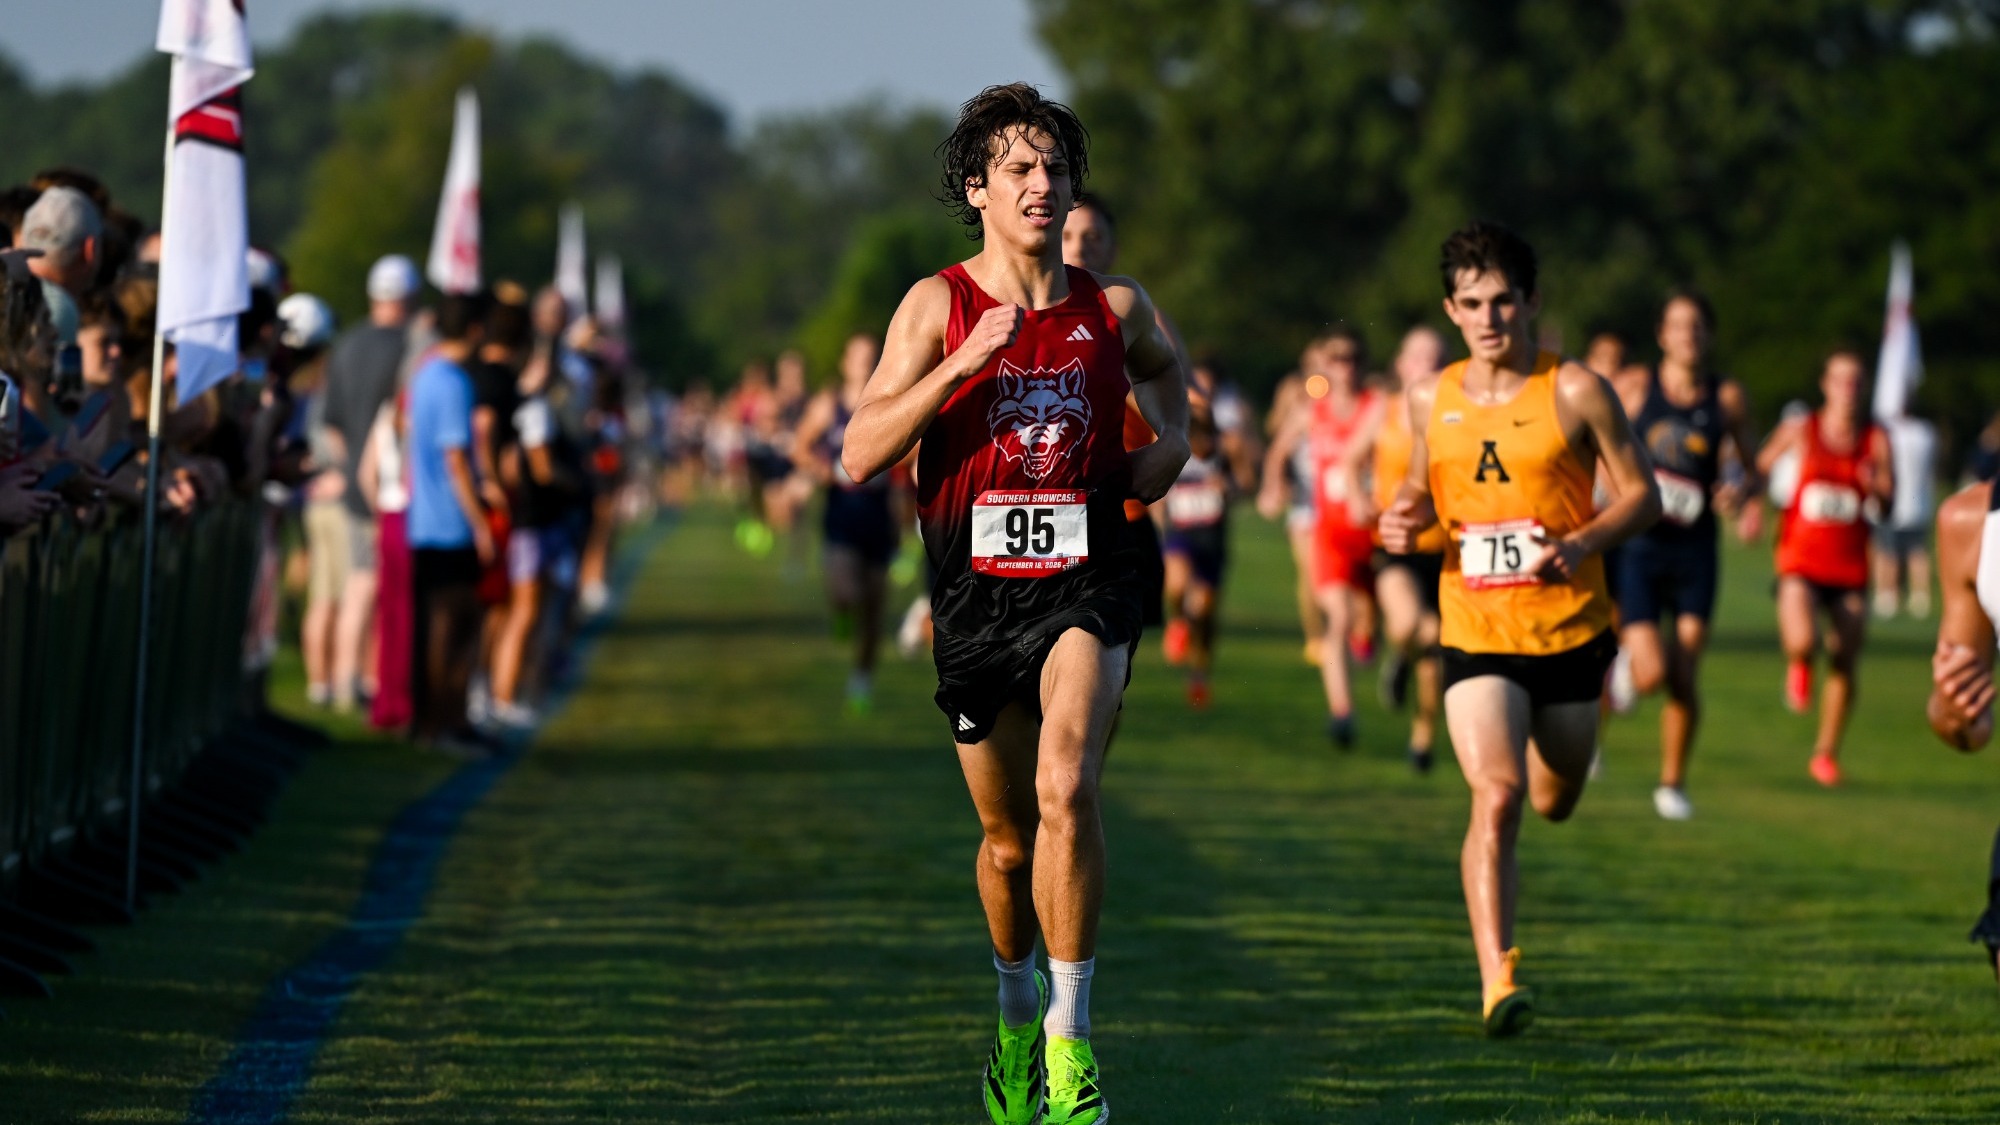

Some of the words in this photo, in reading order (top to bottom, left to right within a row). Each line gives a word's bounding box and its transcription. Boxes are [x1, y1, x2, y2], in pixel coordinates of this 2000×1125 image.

[1474, 441, 1511, 483] A
[987, 494, 1030, 503] SOUTHERN
[1032, 493, 1076, 502] SHOWCASE
[1005, 508, 1055, 556] 95
[996, 561, 1034, 569] SEPTEMBER
[1483, 534, 1522, 574] 75
